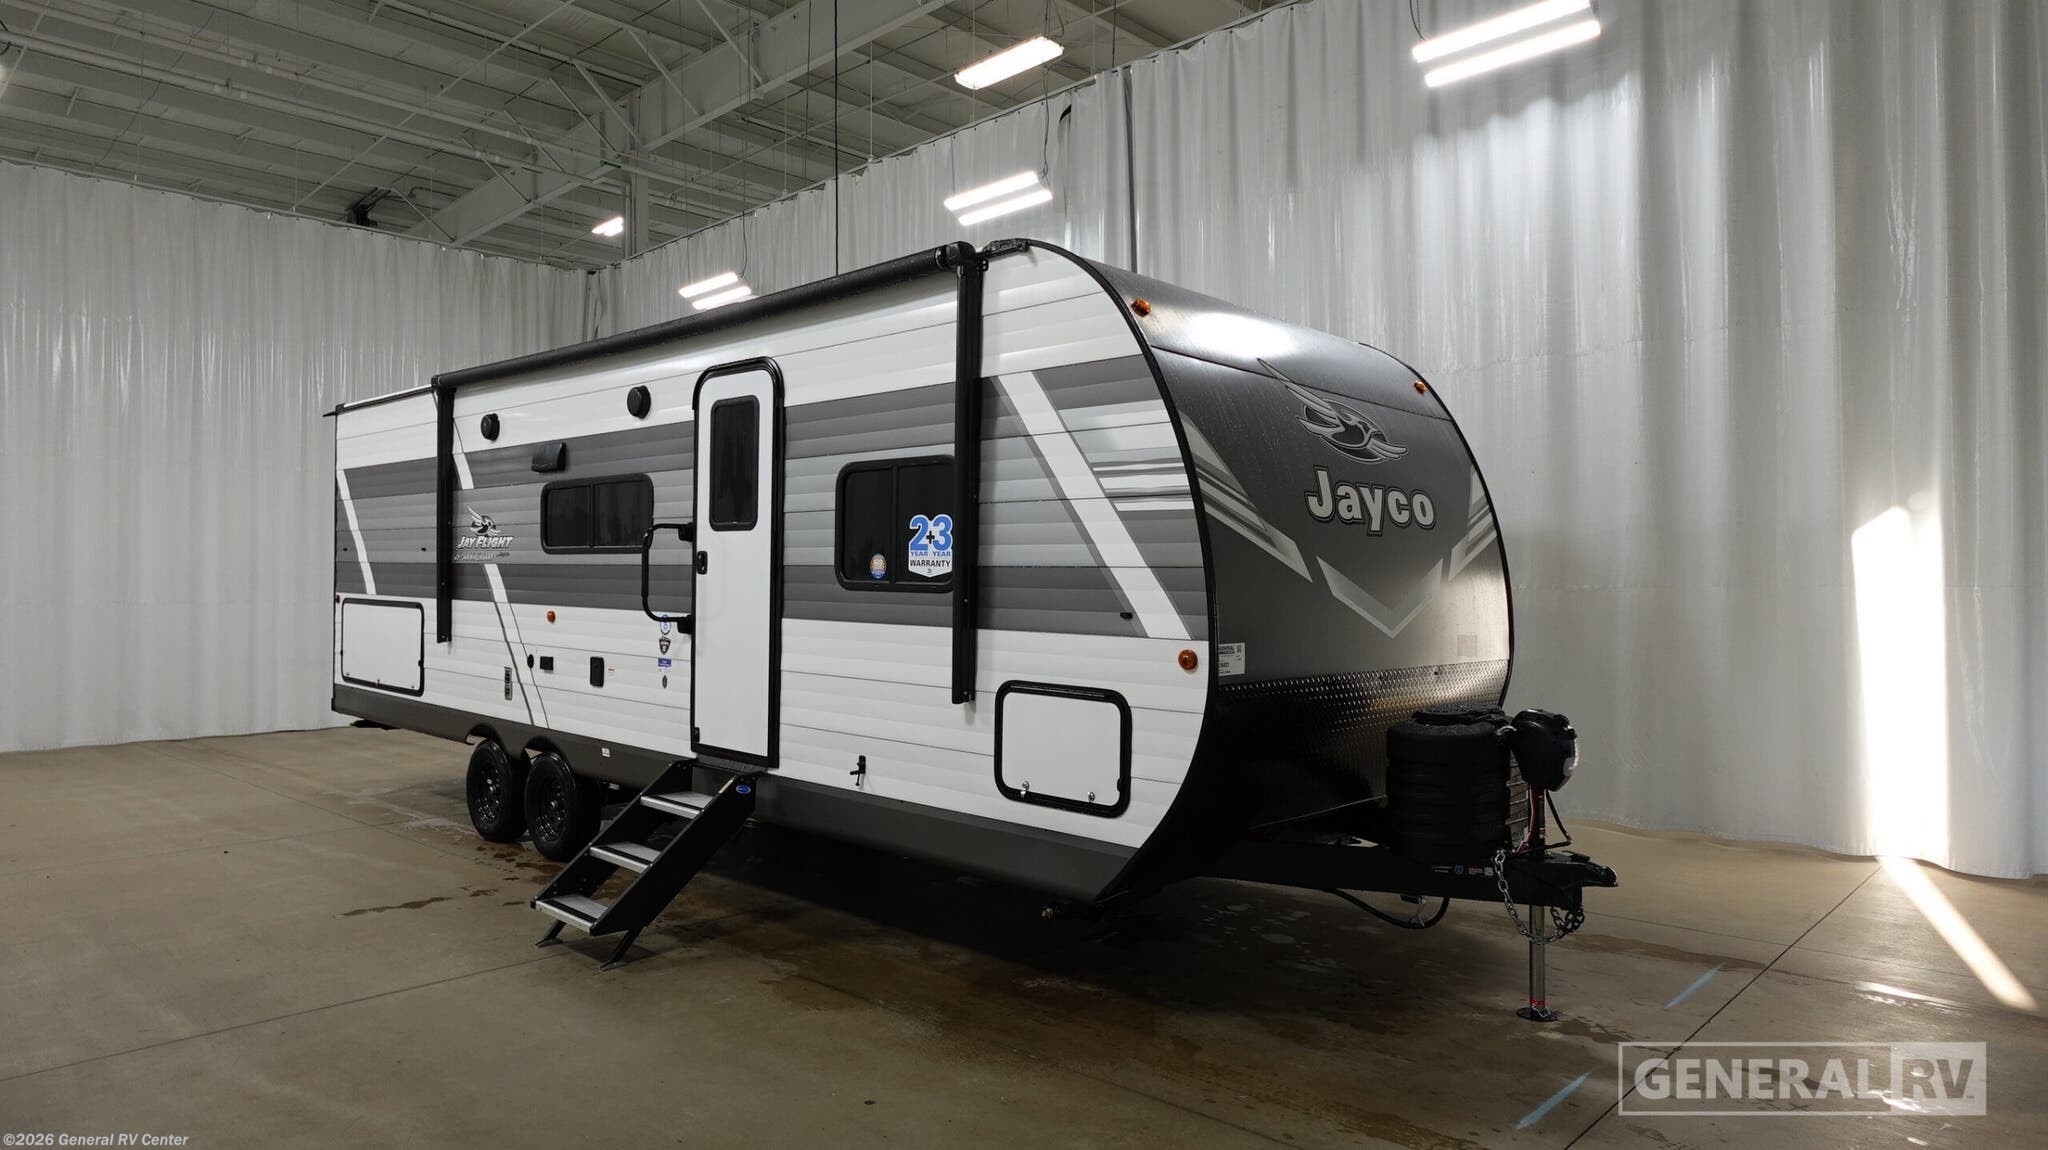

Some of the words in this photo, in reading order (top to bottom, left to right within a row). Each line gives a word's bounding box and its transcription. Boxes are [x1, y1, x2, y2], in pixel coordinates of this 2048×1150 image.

[1304, 466, 1436, 537] Jayco
[456, 536, 476, 549] JAY
[475, 535, 514, 549] FLIGHT
[910, 559, 951, 568] WARRANTY
